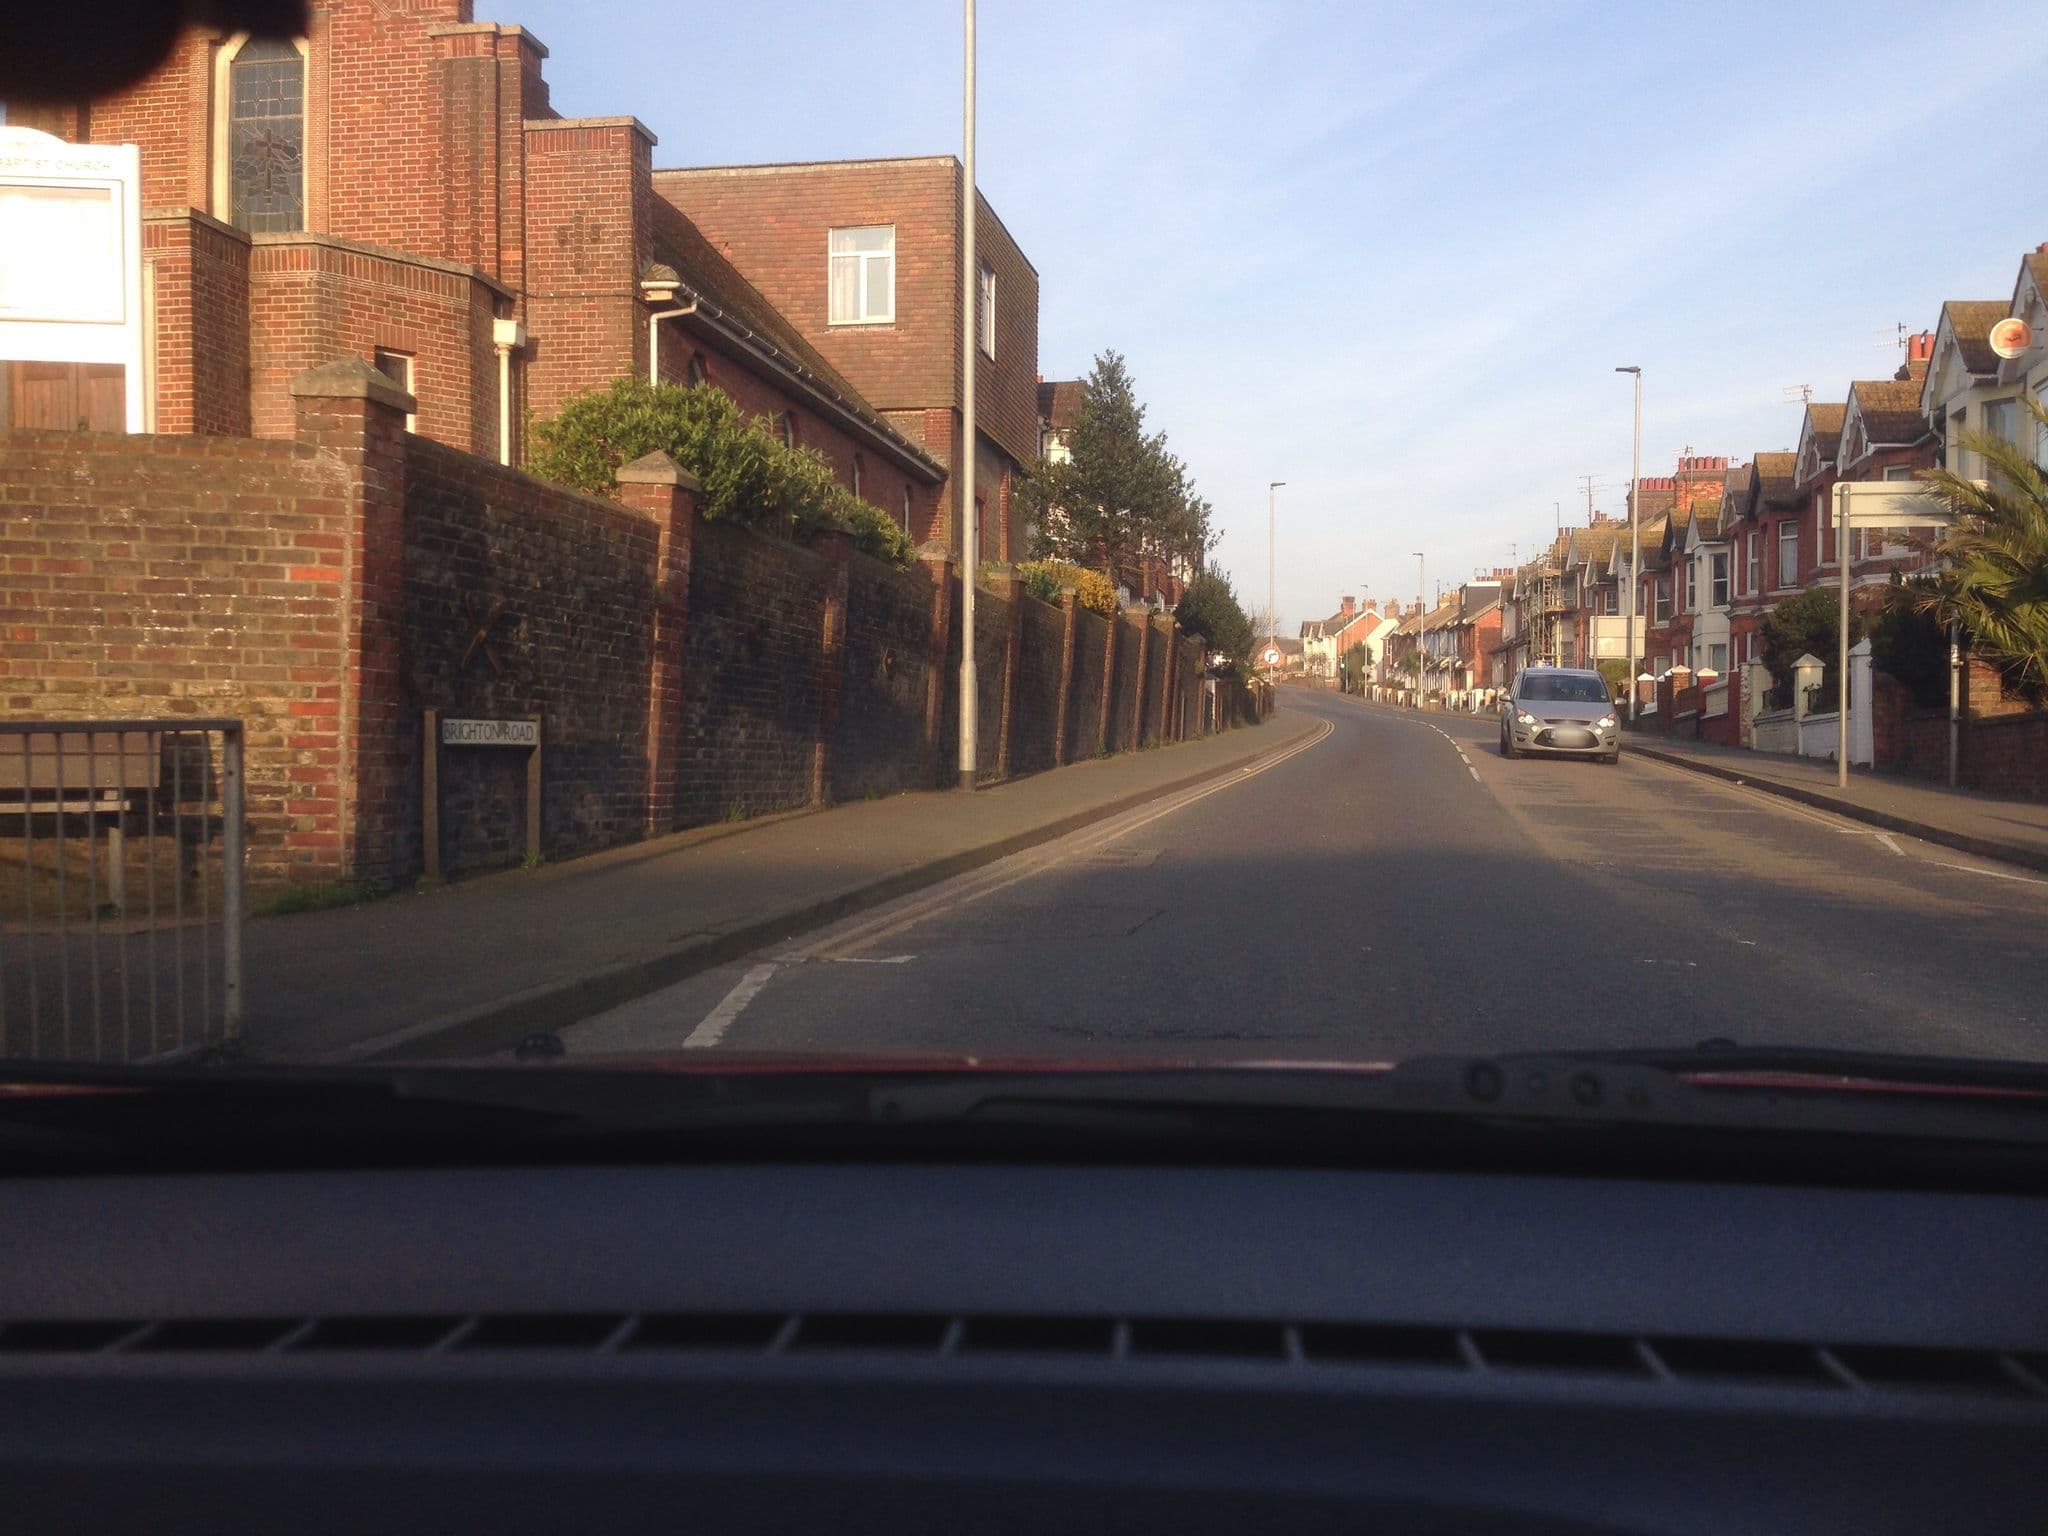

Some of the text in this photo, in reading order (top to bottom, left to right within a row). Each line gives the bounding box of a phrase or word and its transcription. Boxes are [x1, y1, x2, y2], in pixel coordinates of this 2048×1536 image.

[56, 159, 111, 172] CHURCH
[444, 722, 534, 742] BRIGHTON ROAD
